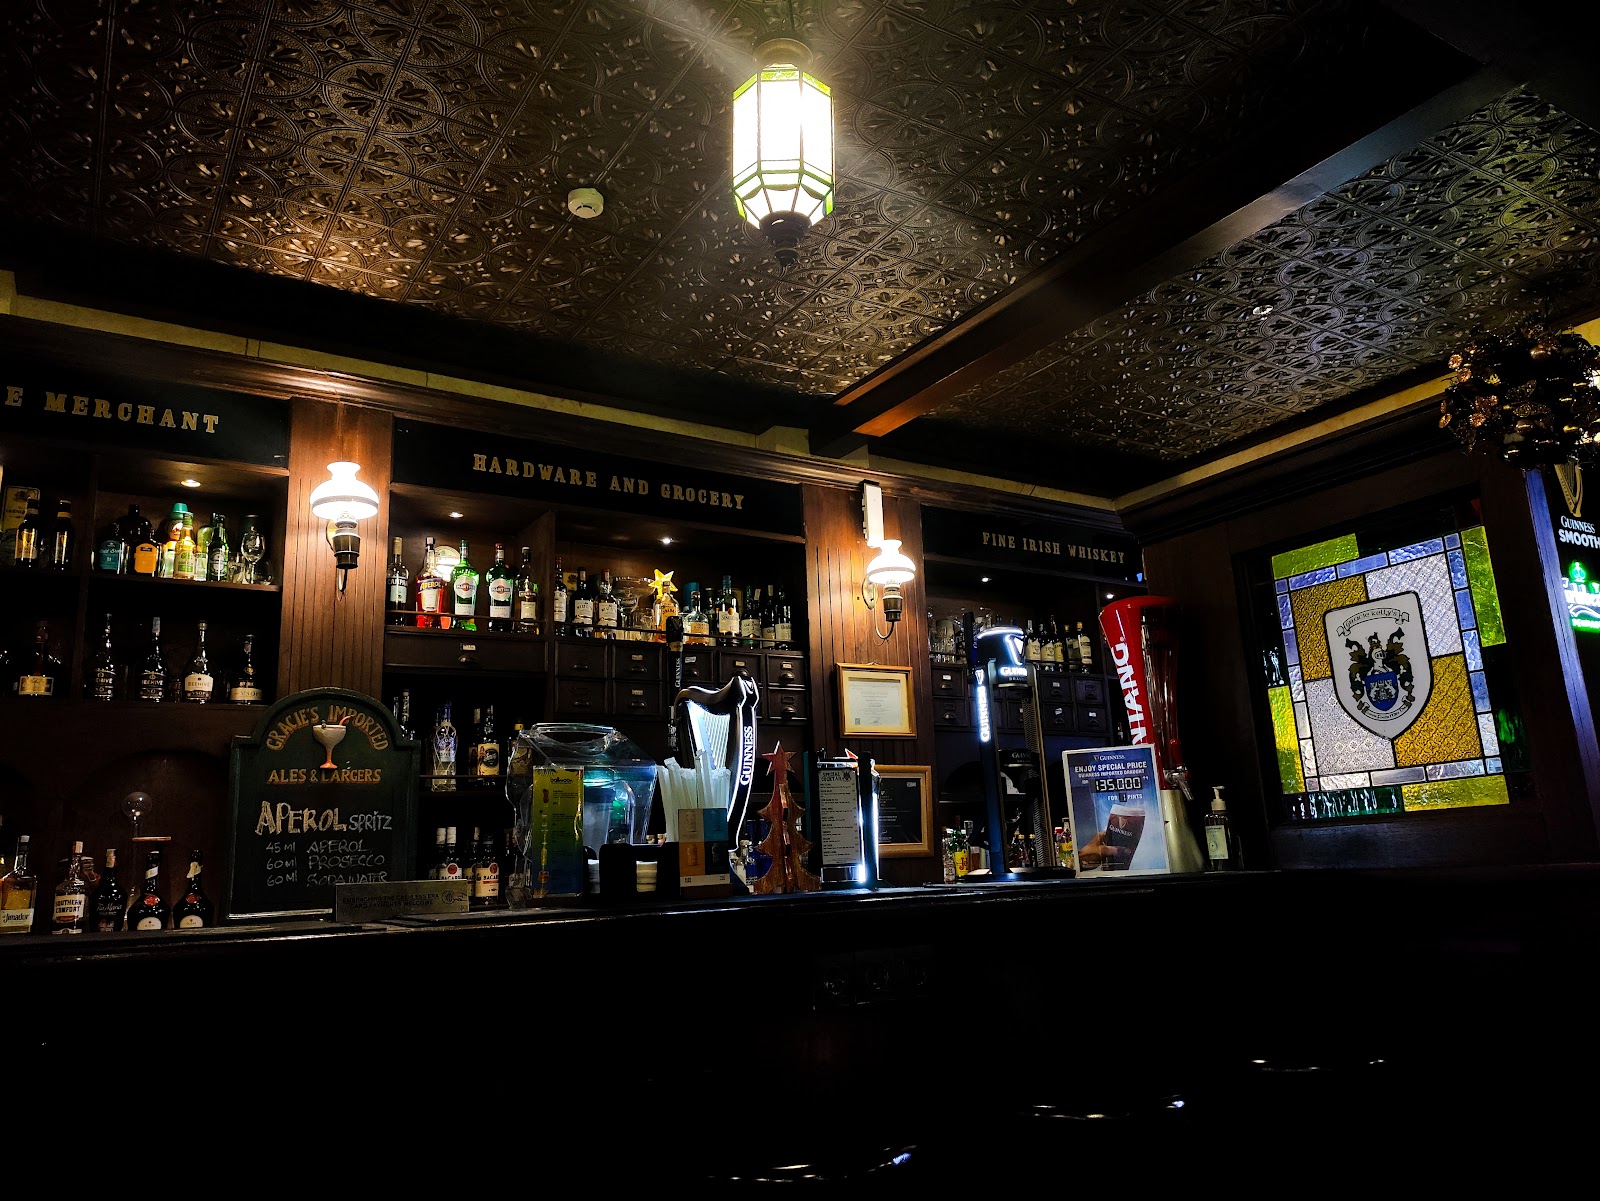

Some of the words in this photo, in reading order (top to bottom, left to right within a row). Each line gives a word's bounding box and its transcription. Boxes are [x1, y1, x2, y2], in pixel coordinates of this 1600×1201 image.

[44, 391, 220, 434] MERCHANT
[473, 453, 598, 488] HARDWARE
[609, 475, 649, 496] AND
[660, 484, 745, 511] GROCERY
[1561, 515, 1596, 534] GUINNESS
[982, 531, 1016, 549] FINE
[1022, 537, 1061, 555] IRISH
[1067, 544, 1125, 564] WHISKEY
[1558, 528, 1600, 550] SMOOTH
[674, 658, 682, 688] GUINNESS
[266, 705, 320, 751] GRACIE'S
[328, 704, 390, 751] IMPORTED
[740, 725, 753, 787] GUINNESS
[1074, 764, 1096, 773] ENJOY
[1097, 762, 1126, 772] SPECIAL
[1126, 761, 1148, 769] PRICE
[267, 768, 307, 785] ALES
[309, 769, 318, 783] &
[320, 768, 383, 785] LARGERS
[255, 800, 347, 836] APEROL
[306, 839, 369, 854] APEROL
[308, 855, 385, 870] PROSECCO
[55, 899, 83, 907] SOUTHERN
[55, 905, 81, 913] COMFORT
